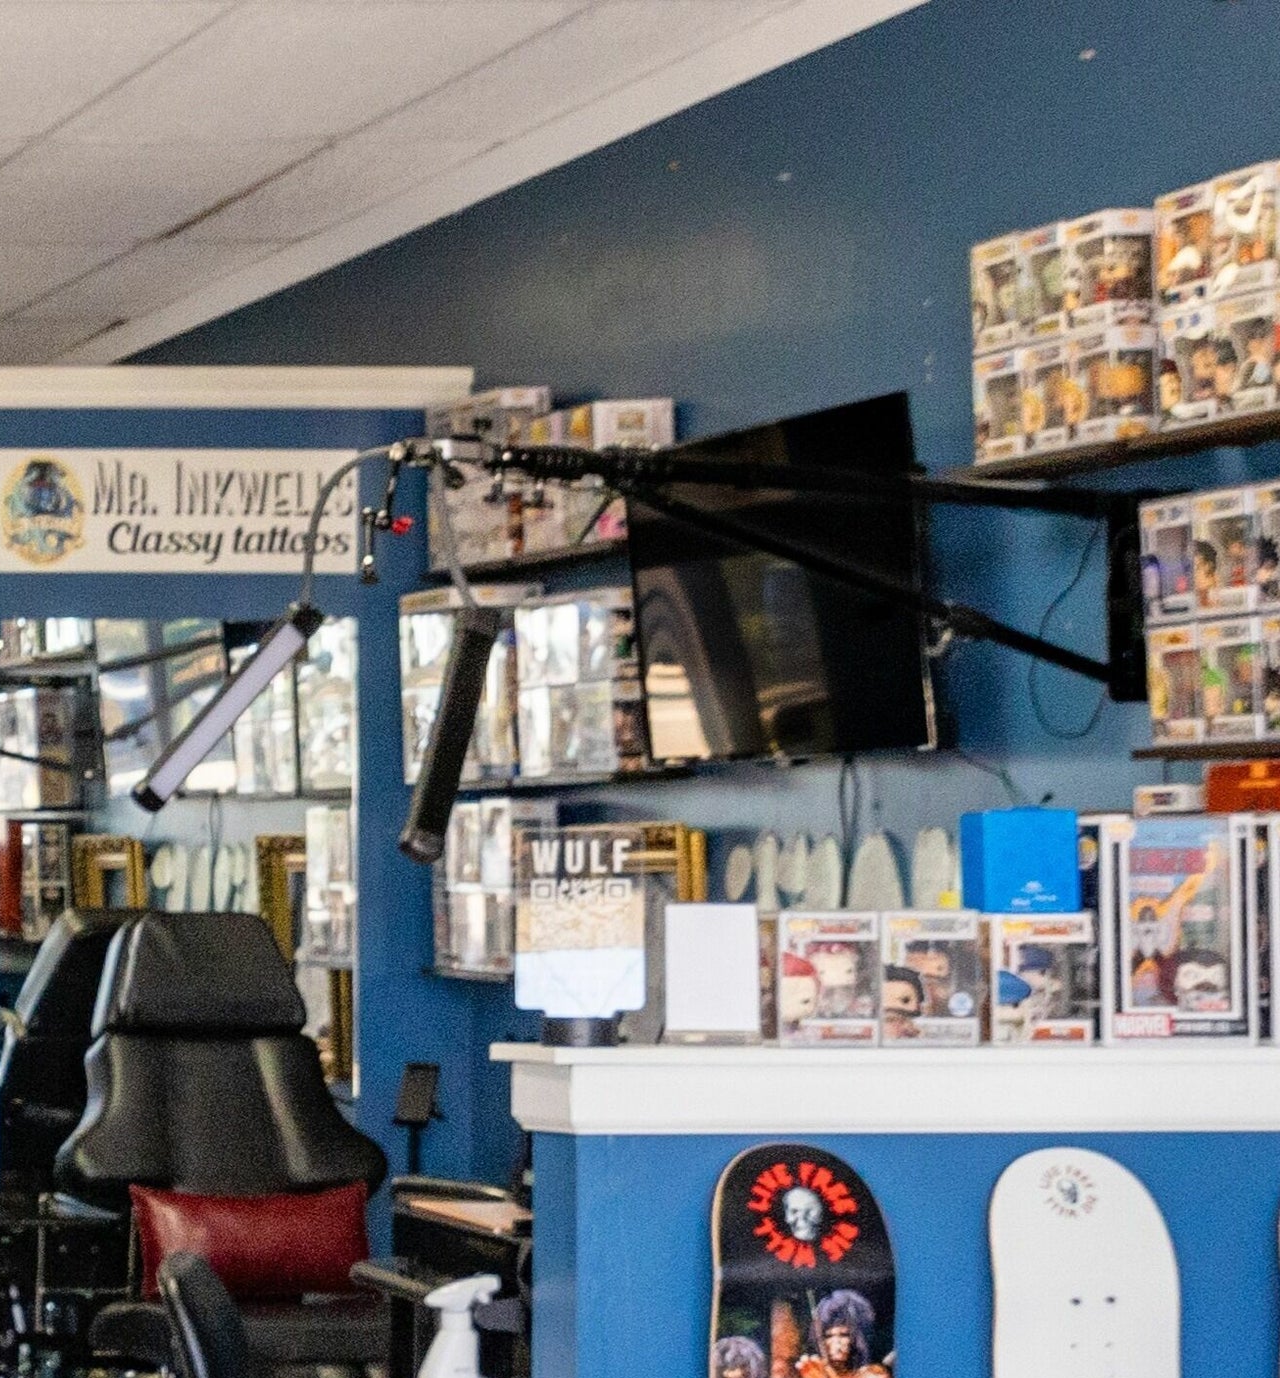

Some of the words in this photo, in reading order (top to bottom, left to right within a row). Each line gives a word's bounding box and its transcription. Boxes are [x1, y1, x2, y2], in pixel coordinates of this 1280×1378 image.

[93, 459, 158, 516] MR.
[107, 520, 224, 565] Classy
[232, 524, 351, 555] tattoos
[530, 838, 633, 874] WULF
[797, 1161, 858, 1215] FREE
